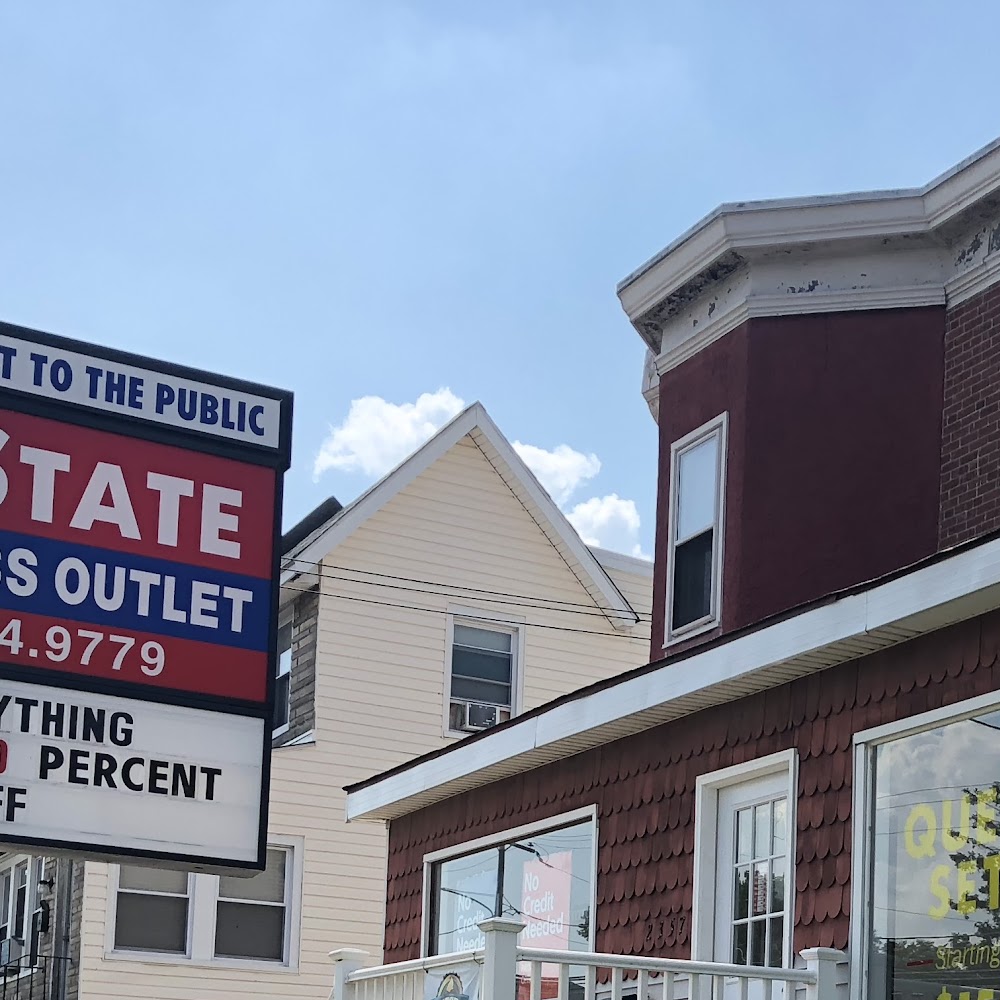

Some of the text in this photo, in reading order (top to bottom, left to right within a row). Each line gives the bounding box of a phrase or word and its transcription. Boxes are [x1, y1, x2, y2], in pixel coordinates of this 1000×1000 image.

[30, 352, 73, 392] TO
[85, 365, 146, 414] THE
[155, 383, 265, 436] PUBLIC
[0, 428, 243, 560] TATE
[55, 557, 253, 633] OUTLET
[39, 745, 222, 801] PERCENT
[524, 873, 540, 893] No
[523, 893, 555, 915] Credit
[522, 913, 564, 939] Needed
[935, 943, 1000, 970] Starting
